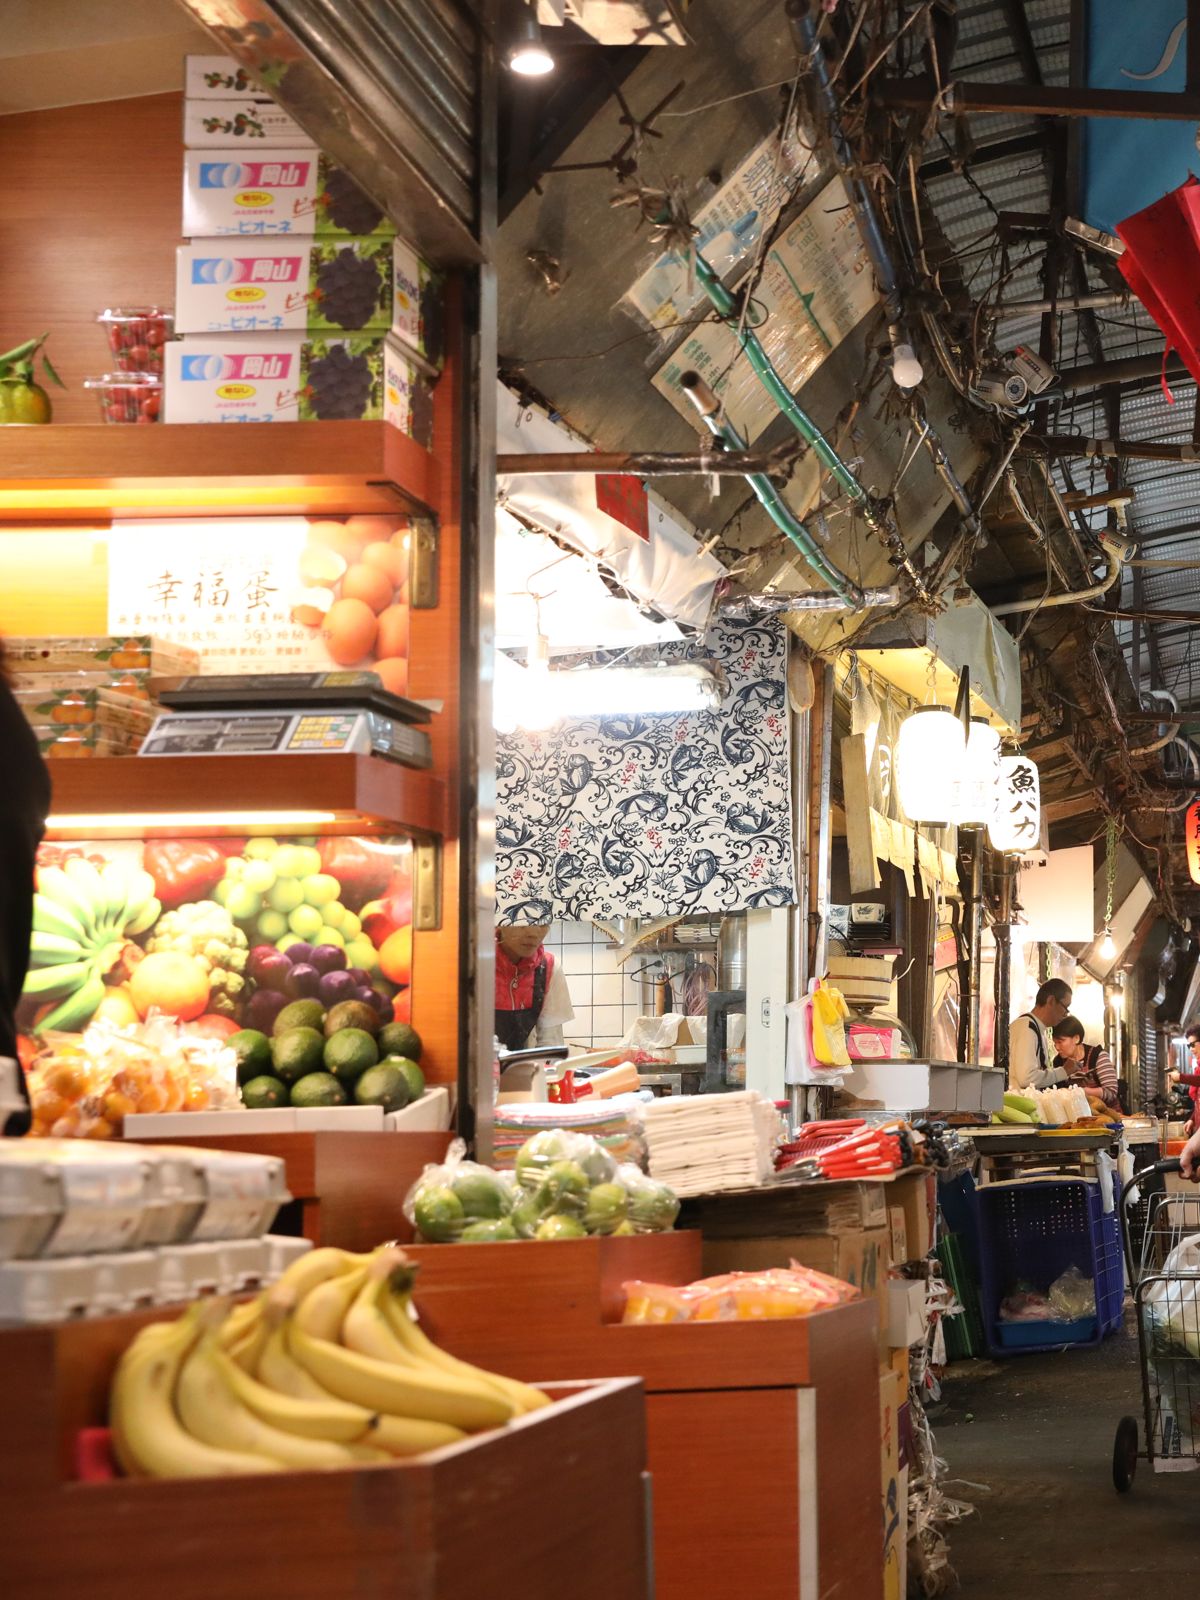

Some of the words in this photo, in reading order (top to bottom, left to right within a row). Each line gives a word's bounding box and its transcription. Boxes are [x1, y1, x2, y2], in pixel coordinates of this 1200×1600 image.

[259, 163, 300, 186] 岡山
[251, 258, 292, 281] 岡山
[241, 355, 283, 378] 岡山
[148, 569, 279, 609] 幸福蛋
[1006, 764, 1037, 839] 魚バカ
